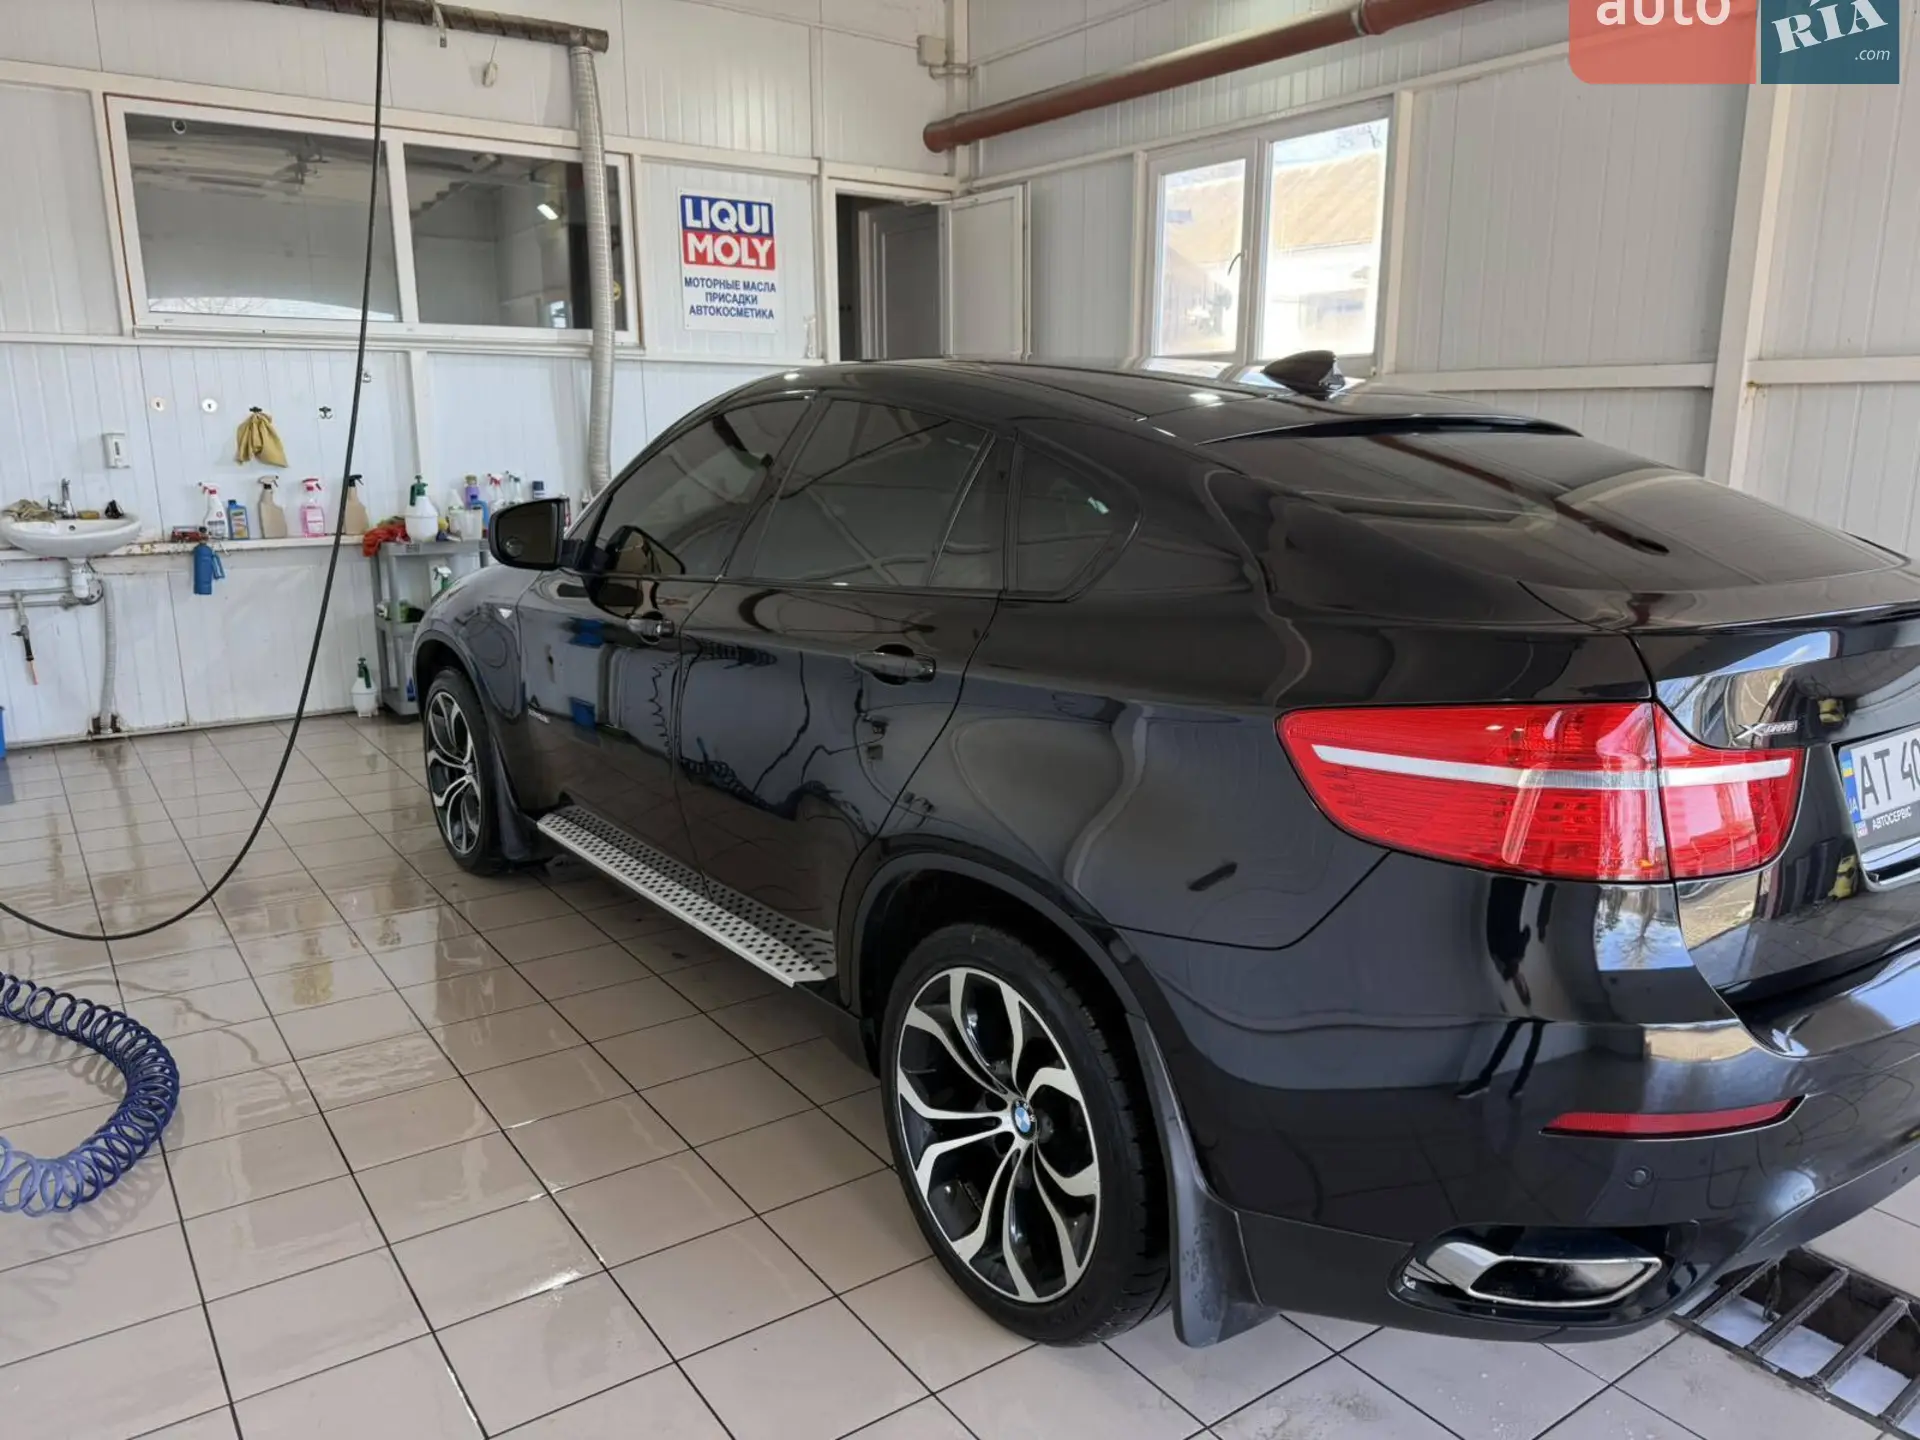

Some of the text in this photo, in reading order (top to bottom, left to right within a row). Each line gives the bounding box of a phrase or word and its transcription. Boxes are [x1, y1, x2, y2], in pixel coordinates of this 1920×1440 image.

[684, 197, 770, 234] LIQUI
[686, 232, 773, 268] MOLY
[684, 276, 777, 293] МОТОРНЫЕ МАСЛА
[705, 291, 758, 307] ПРИСАДКИ
[688, 305, 775, 320] АВТОКОСМЕТИКА
[1860, 748, 1892, 810] AT
